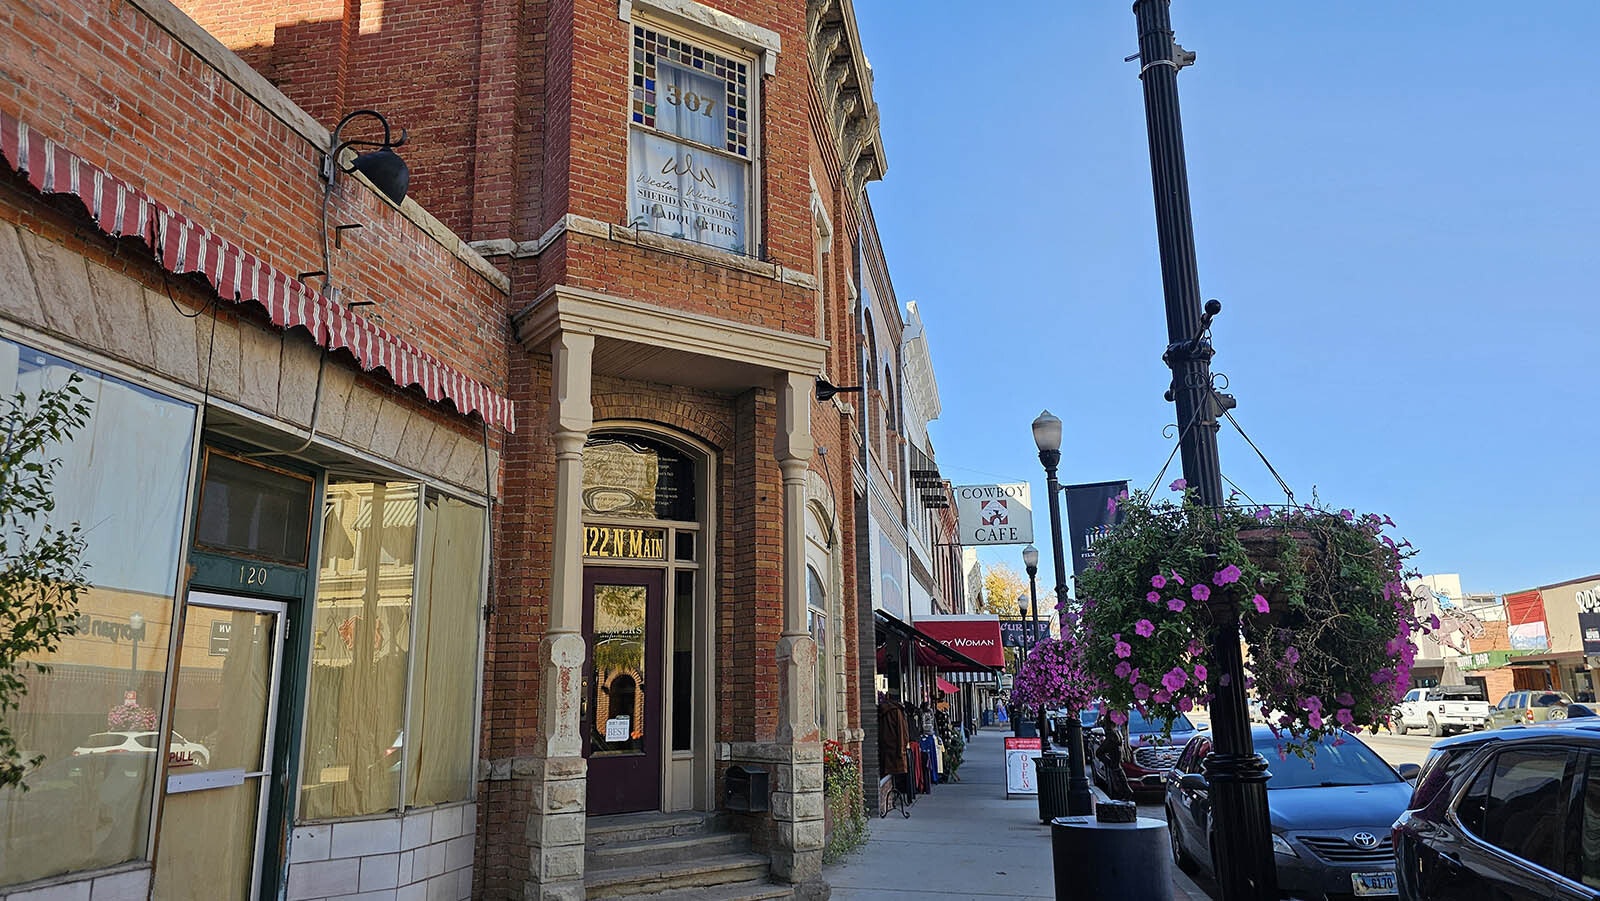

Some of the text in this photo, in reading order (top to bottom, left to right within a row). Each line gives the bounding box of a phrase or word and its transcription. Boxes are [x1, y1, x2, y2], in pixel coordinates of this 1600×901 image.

[666, 84, 716, 118] 307
[637, 188, 739, 223] SHERIDAN WYOMING
[962, 486, 1025, 499] COWBOY
[583, 527, 663, 558] 122 N MAIN
[975, 527, 1018, 542] CAFE
[239, 566, 267, 585] 120
[955, 637, 994, 647] WOMAN
[169, 751, 194, 762] PULL
[1021, 754, 1029, 788] OPEN
